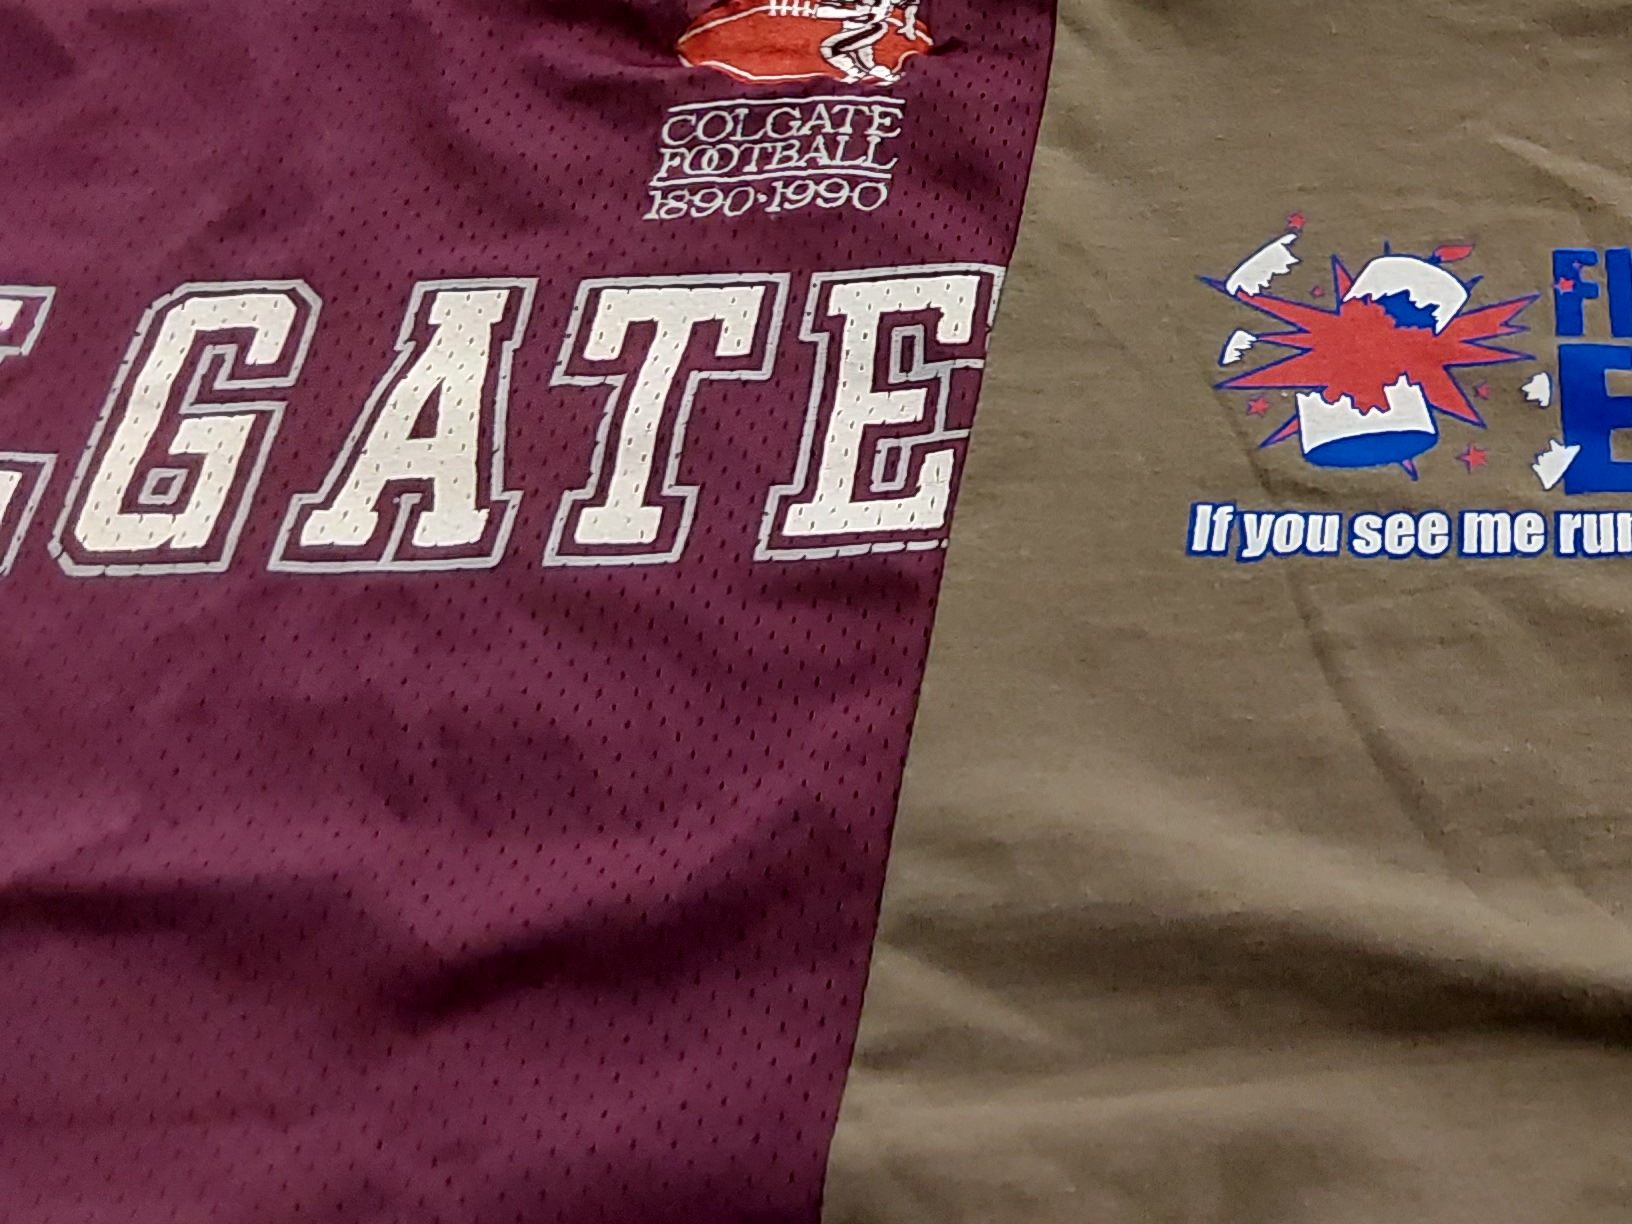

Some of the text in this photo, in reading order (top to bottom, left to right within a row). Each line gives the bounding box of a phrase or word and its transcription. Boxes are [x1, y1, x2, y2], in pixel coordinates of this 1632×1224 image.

[662, 103, 903, 146] COLGATE
[653, 135, 899, 182] FOOTBALL
[0, 265, 1006, 576] GATE
[1188, 503, 1236, 556] If
[1240, 511, 1342, 560] you
[1350, 511, 1452, 557] see
[1460, 510, 1547, 557] me
